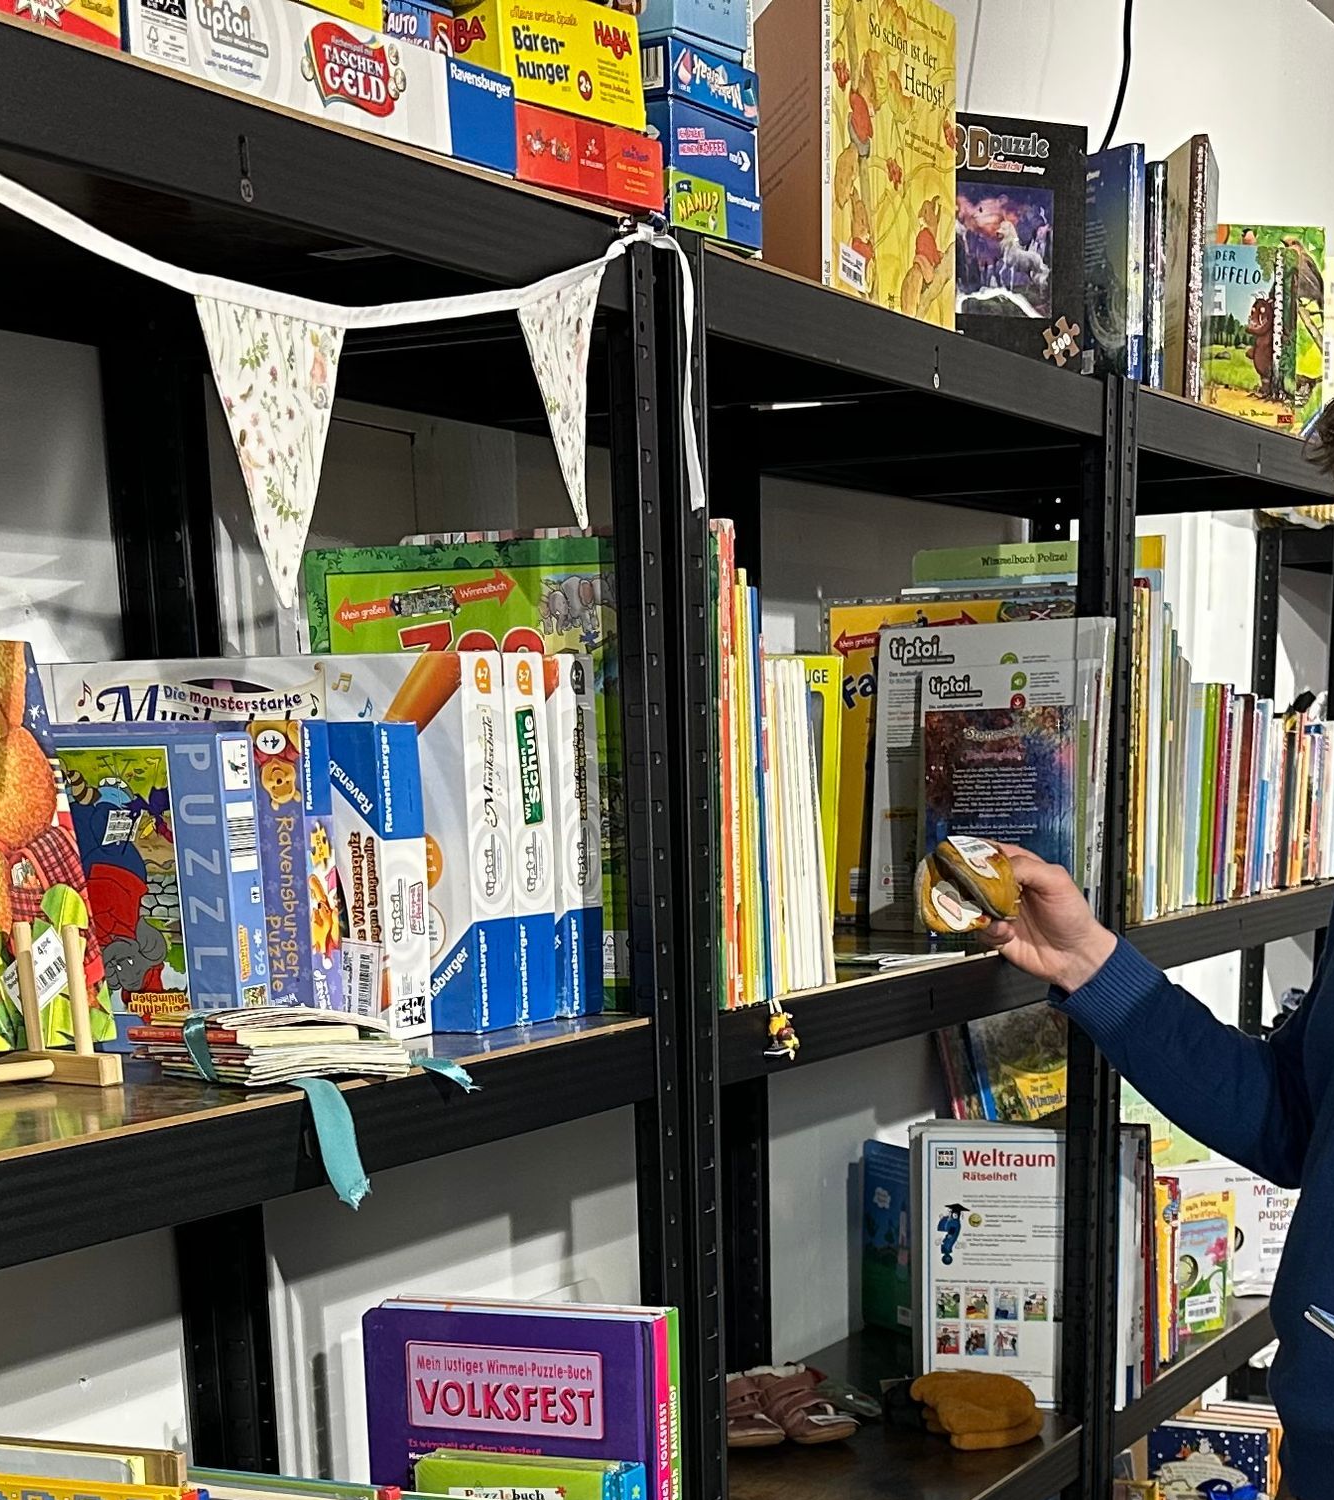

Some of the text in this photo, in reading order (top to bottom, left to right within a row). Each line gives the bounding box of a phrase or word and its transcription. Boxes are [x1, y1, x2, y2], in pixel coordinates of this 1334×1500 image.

[196, 0, 251, 40] tiptoi
[387, 12, 418, 34] AUTO
[511, 24, 566, 55] Bären-
[593, 20, 633, 60] HABA
[869, 12, 881, 39] So
[882, 25, 909, 56] schön
[911, 41, 922, 63] ist
[922, 44, 939, 71] der
[322, 44, 385, 78] TASCHEN
[515, 54, 571, 85] hunger
[450, 62, 512, 99] Ravensburger
[579, 75, 592, 94] 2+
[904, 63, 948, 110] Herbst!
[988, 133, 1049, 158] puzzle
[677, 191, 720, 223] NANU?
[1215, 250, 1237, 263] DER
[1051, 333, 1072, 356] 500
[981, 553, 1034, 566] Wimmelbuch
[341, 581, 508, 621] Mein großes Wimmelbuch
[838, 638, 854, 649] Mein
[890, 634, 940, 665] tiptoi
[477, 668, 490, 682] 4-7
[929, 675, 971, 698] tiptoi
[164, 685, 187, 701] Die
[189, 692, 303, 714] monsterstarke
[303, 726, 314, 812] Ravensburger
[378, 728, 395, 835] Ravensburger
[483, 715, 499, 829] Musikschule
[350, 830, 362, 929] Wissensquiz
[485, 848, 496, 897] tiptoi
[526, 843, 538, 893] tiptoi
[275, 815, 300, 984] Ravensburger
[265, 914, 284, 993] puzzle
[520, 923, 530, 1019] Ravensburger
[570, 916, 581, 1011] Ravensburger
[479, 928, 491, 1028] Ravensburger
[130, 992, 190, 1005] Blümchen
[962, 1148, 1056, 1168] Weltraum
[962, 1171, 1018, 1182] Rätselheft
[1253, 1184, 1283, 1197] Mein
[416, 1355, 593, 1382] Mein lustiges Wimmel-Puzzle-Buch
[414, 1377, 595, 1427] VOLKSFEST
[657, 1402, 669, 1470] VOLKSFEST
[668, 1384, 680, 1460] BAUERNHOF
